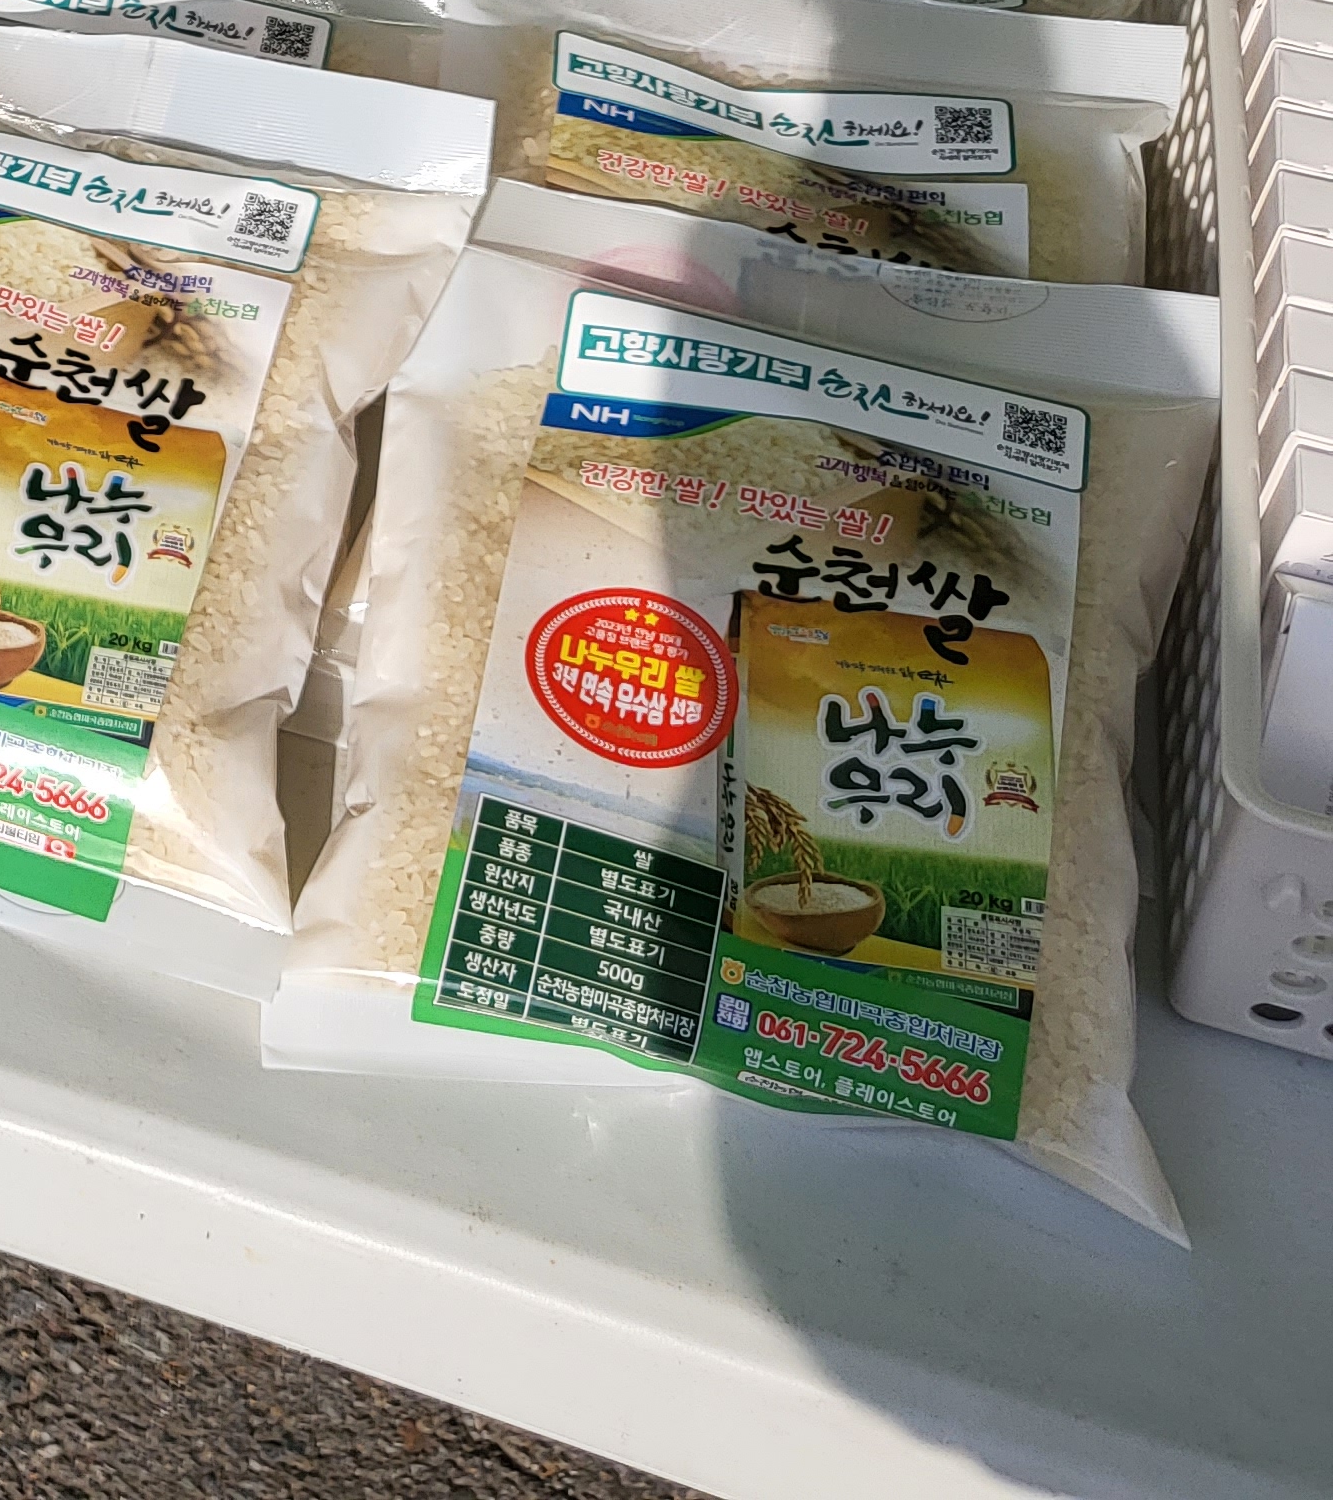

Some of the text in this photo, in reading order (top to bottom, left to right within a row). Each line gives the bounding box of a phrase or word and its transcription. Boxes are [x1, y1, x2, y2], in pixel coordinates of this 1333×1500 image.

[568, 54, 763, 129] 고향사랑기부
[581, 97, 636, 121] NH
[596, 149, 676, 188] 건강한
[738, 185, 811, 221] 맛있는
[581, 324, 810, 389] 고향사랑기부
[569, 402, 631, 426] NH
[24, 465, 153, 524] 나누
[577, 461, 668, 497] 건강한
[737, 484, 830, 531] 맛있는
[15, 514, 135, 585] 우리
[751, 533, 1011, 664] 순천쌀
[559, 633, 706, 698] 나누우리 쌀
[825, 690, 979, 766] 나누
[826, 756, 967, 838] 우리
